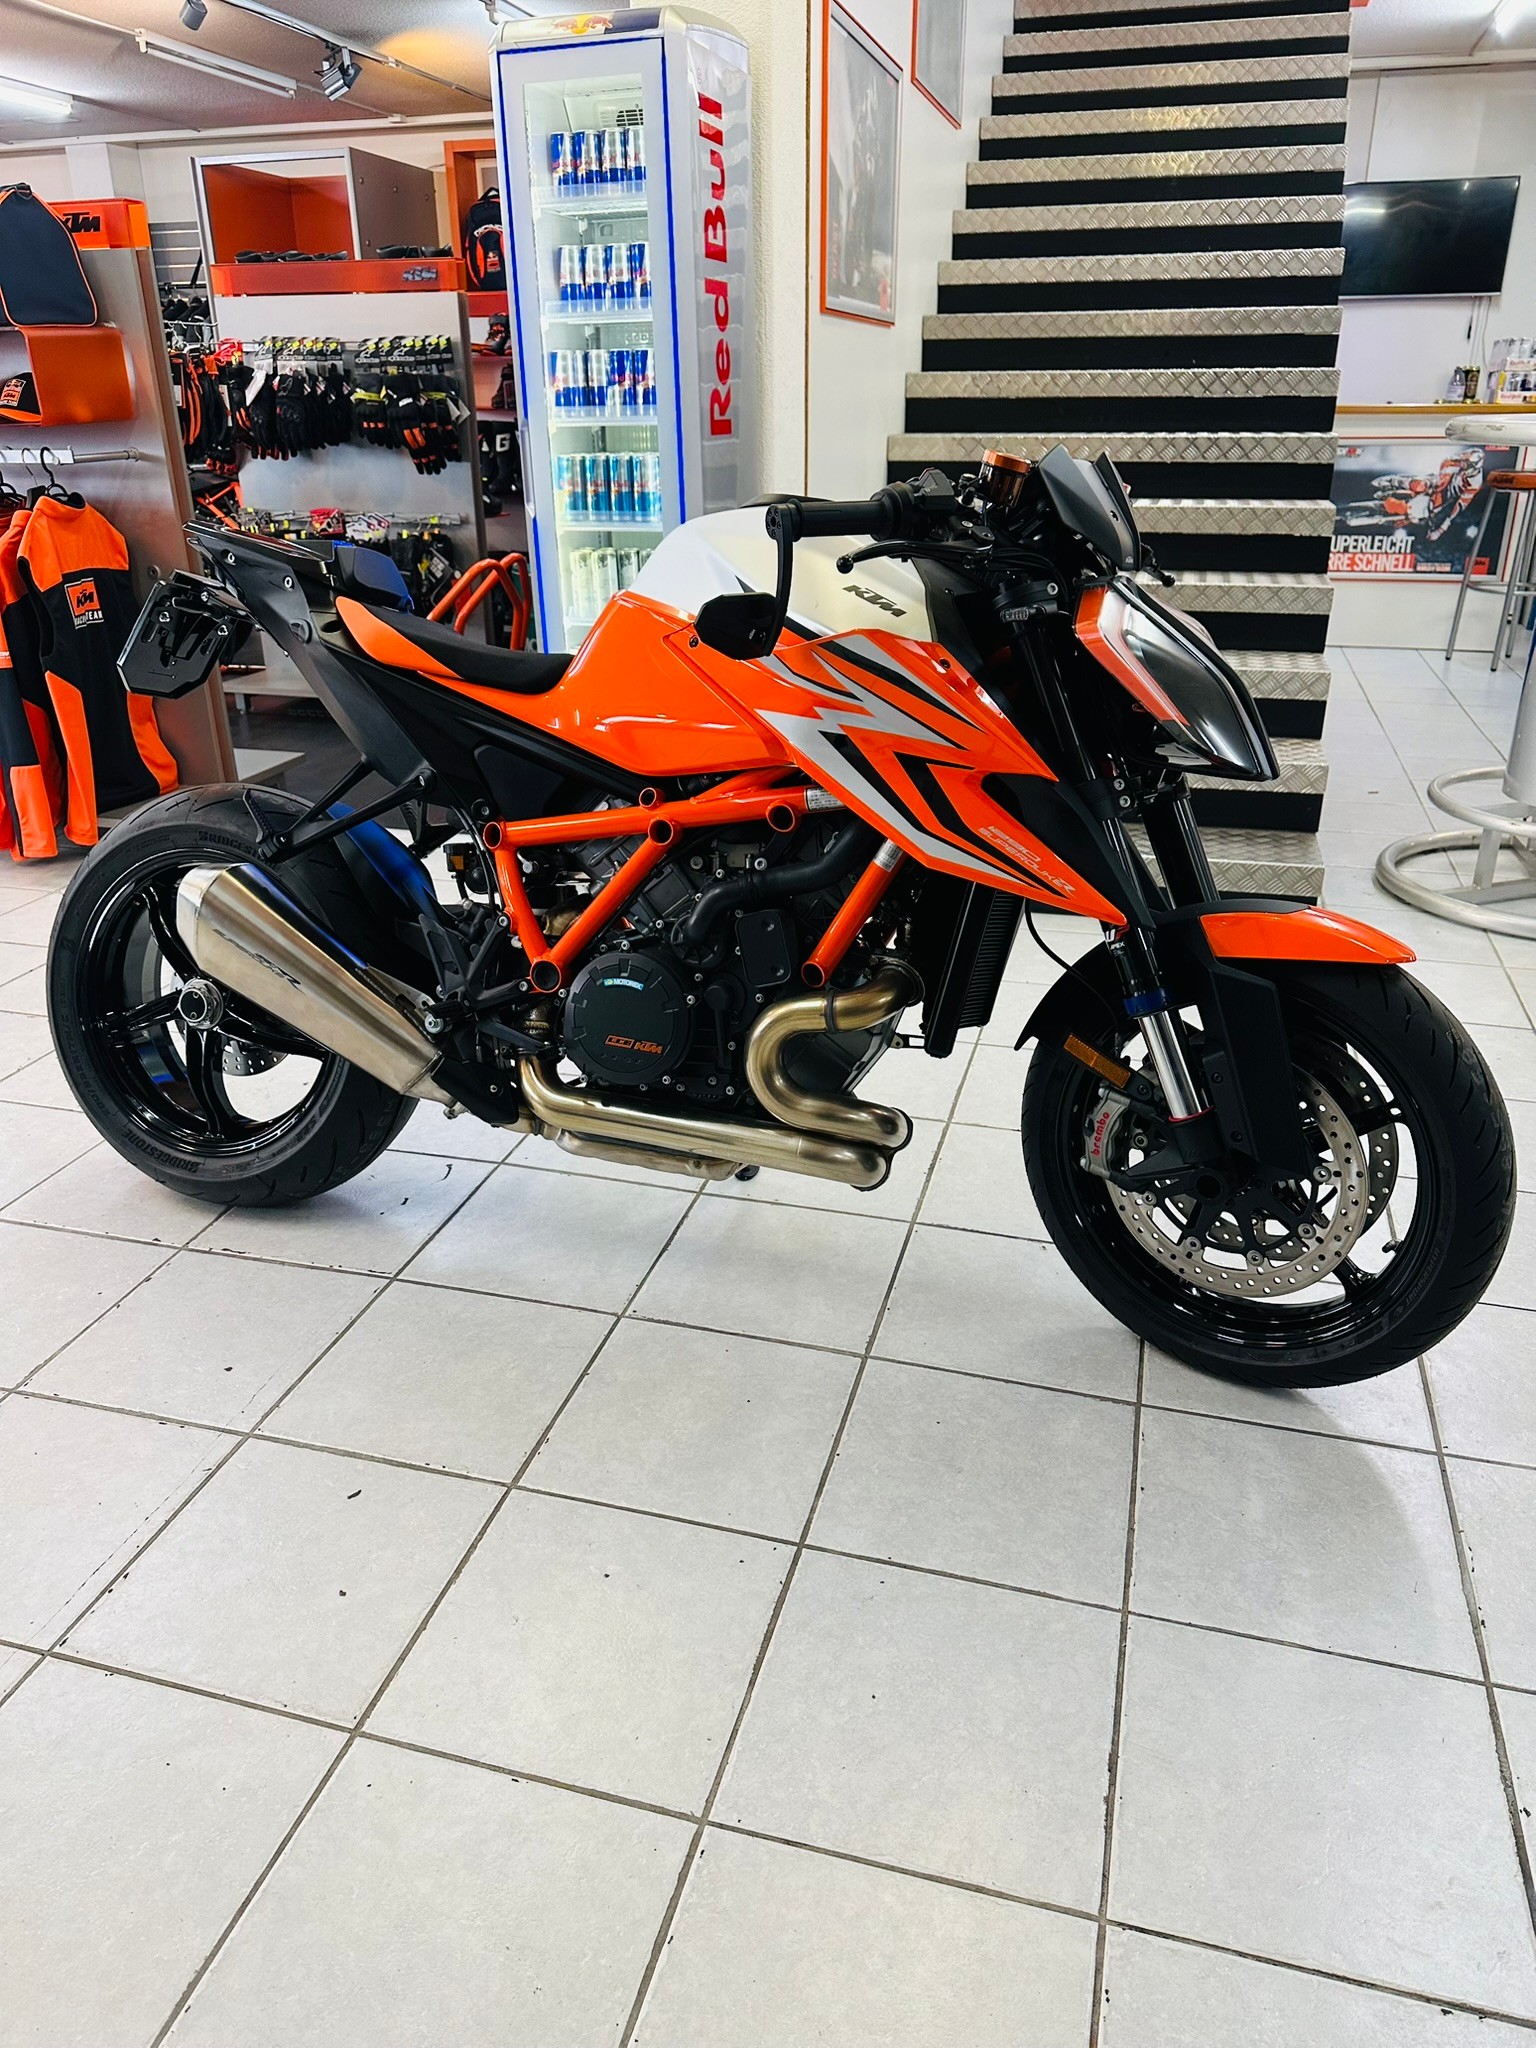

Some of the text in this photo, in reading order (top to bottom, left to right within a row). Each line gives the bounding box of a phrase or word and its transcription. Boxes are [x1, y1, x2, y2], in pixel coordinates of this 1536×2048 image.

[696, 90, 733, 437] Red Bull
[1330, 534, 1416, 553] UPERLEICHT
[76, 588, 95, 609] KTM
[842, 584, 907, 618] KTM
[613, 977, 645, 991] MOTOREX
[633, 1040, 663, 1055] KTM
[1090, 1111, 1110, 1156] brembo
[121, 1128, 202, 1174] BRIDGESTONE
